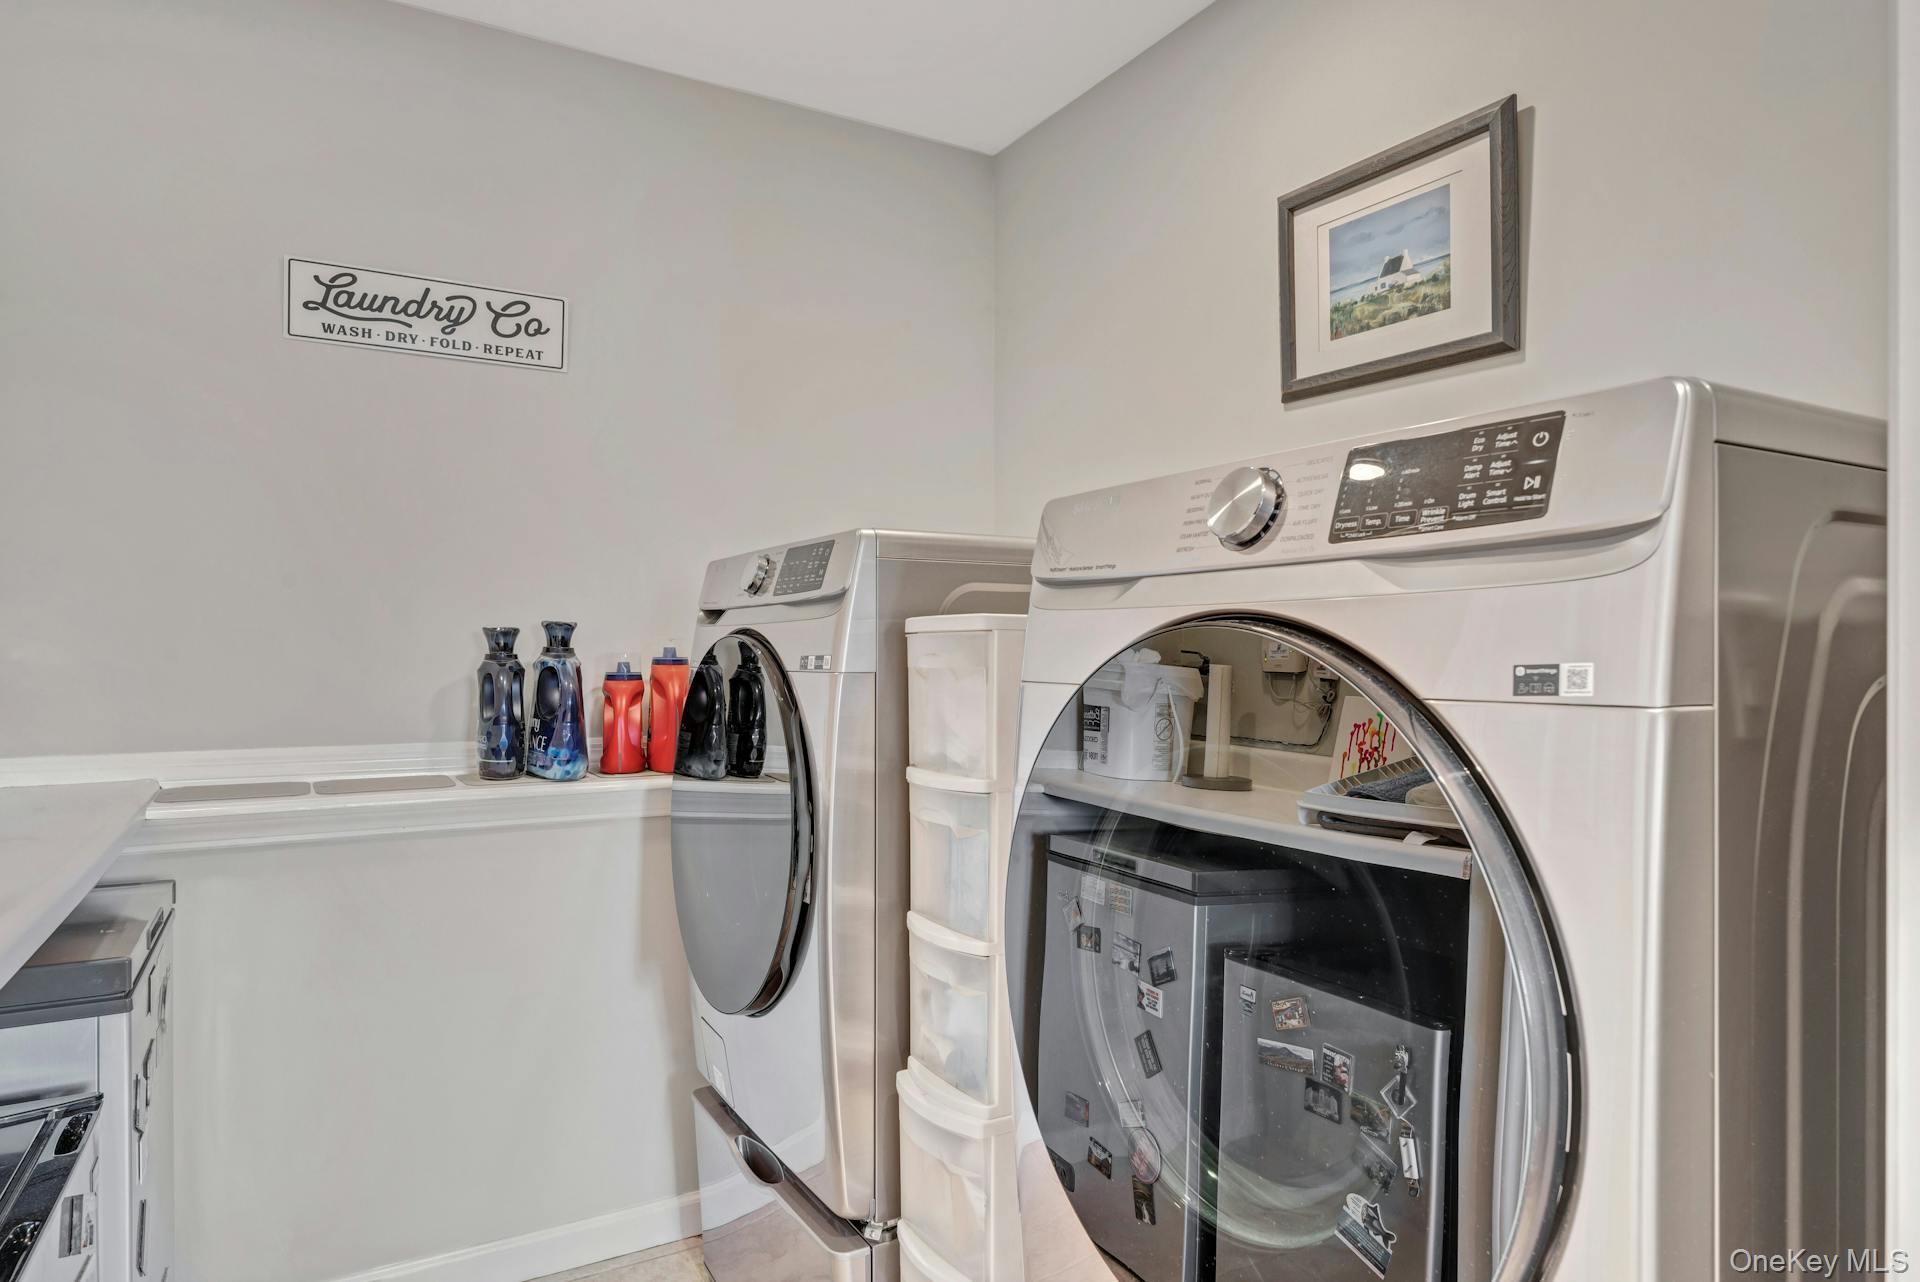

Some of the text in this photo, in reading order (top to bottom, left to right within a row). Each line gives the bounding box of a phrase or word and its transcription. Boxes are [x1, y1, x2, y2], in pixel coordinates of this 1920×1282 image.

[302, 272, 550, 339] Laundry Co
[321, 322, 544, 361] WASH DRY FOLD REPEAT
[1495, 431, 1518, 441] Adjust
